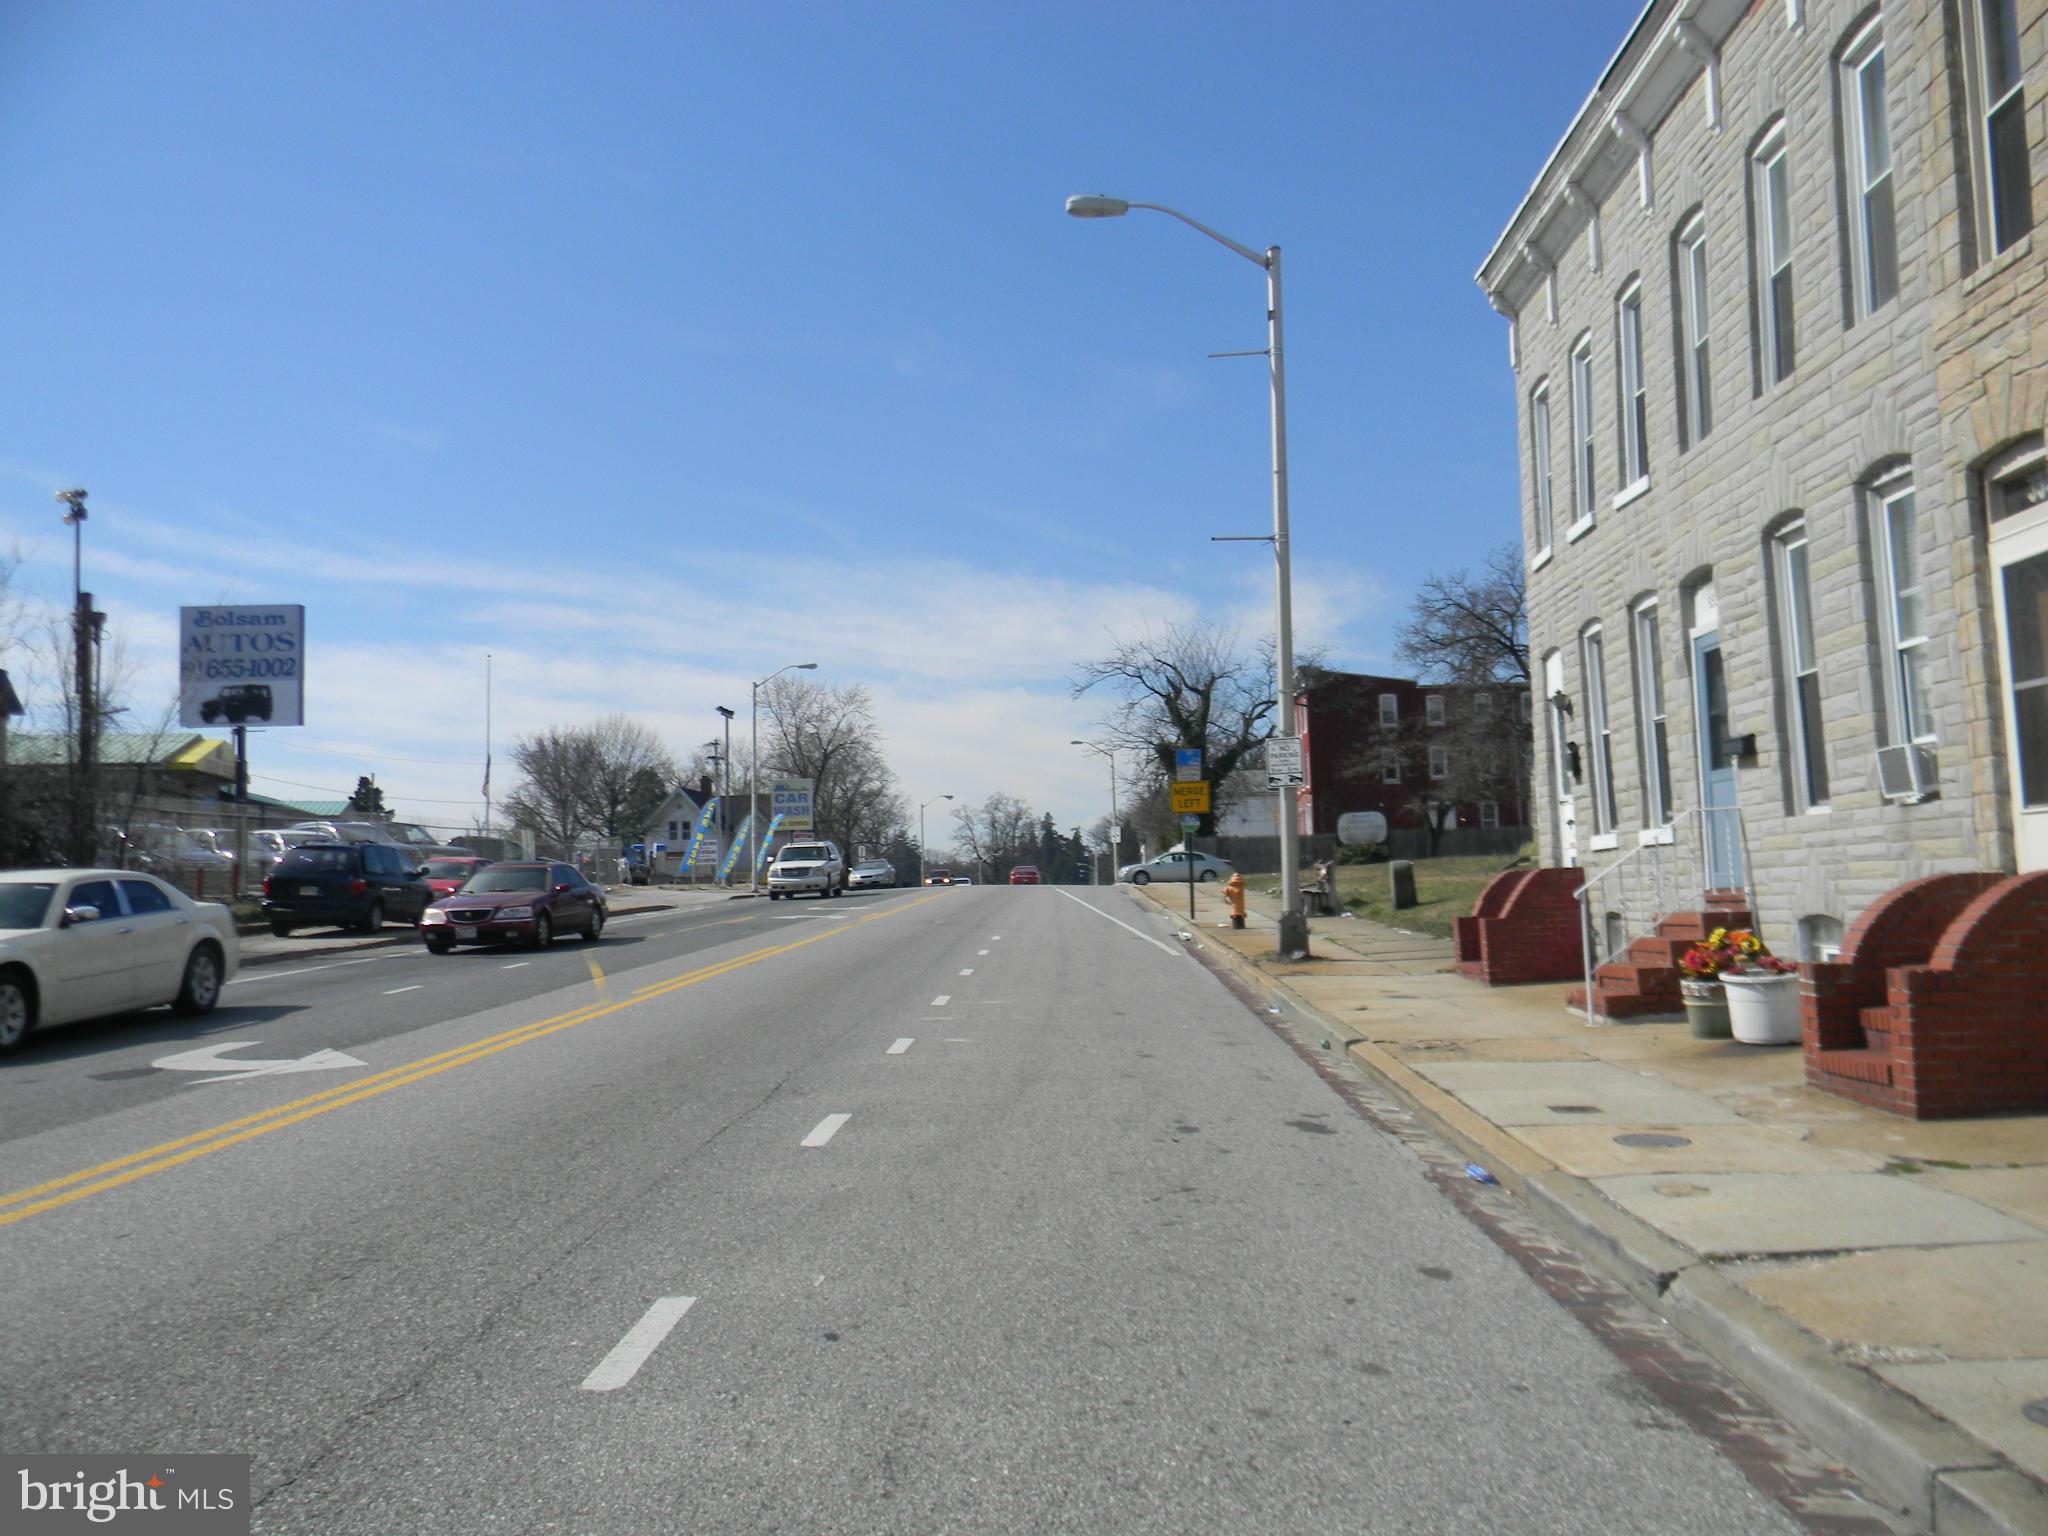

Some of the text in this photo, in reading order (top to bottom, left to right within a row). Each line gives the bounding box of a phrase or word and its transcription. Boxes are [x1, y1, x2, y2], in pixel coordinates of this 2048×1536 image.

[184, 632, 295, 653] AUTOS
[206, 658, 296, 678] 655-1002
[1174, 786, 1207, 796] MERGE
[775, 792, 809, 804] CAR
[1179, 798, 1201, 808] LEFT
[773, 805, 810, 817] WASH
